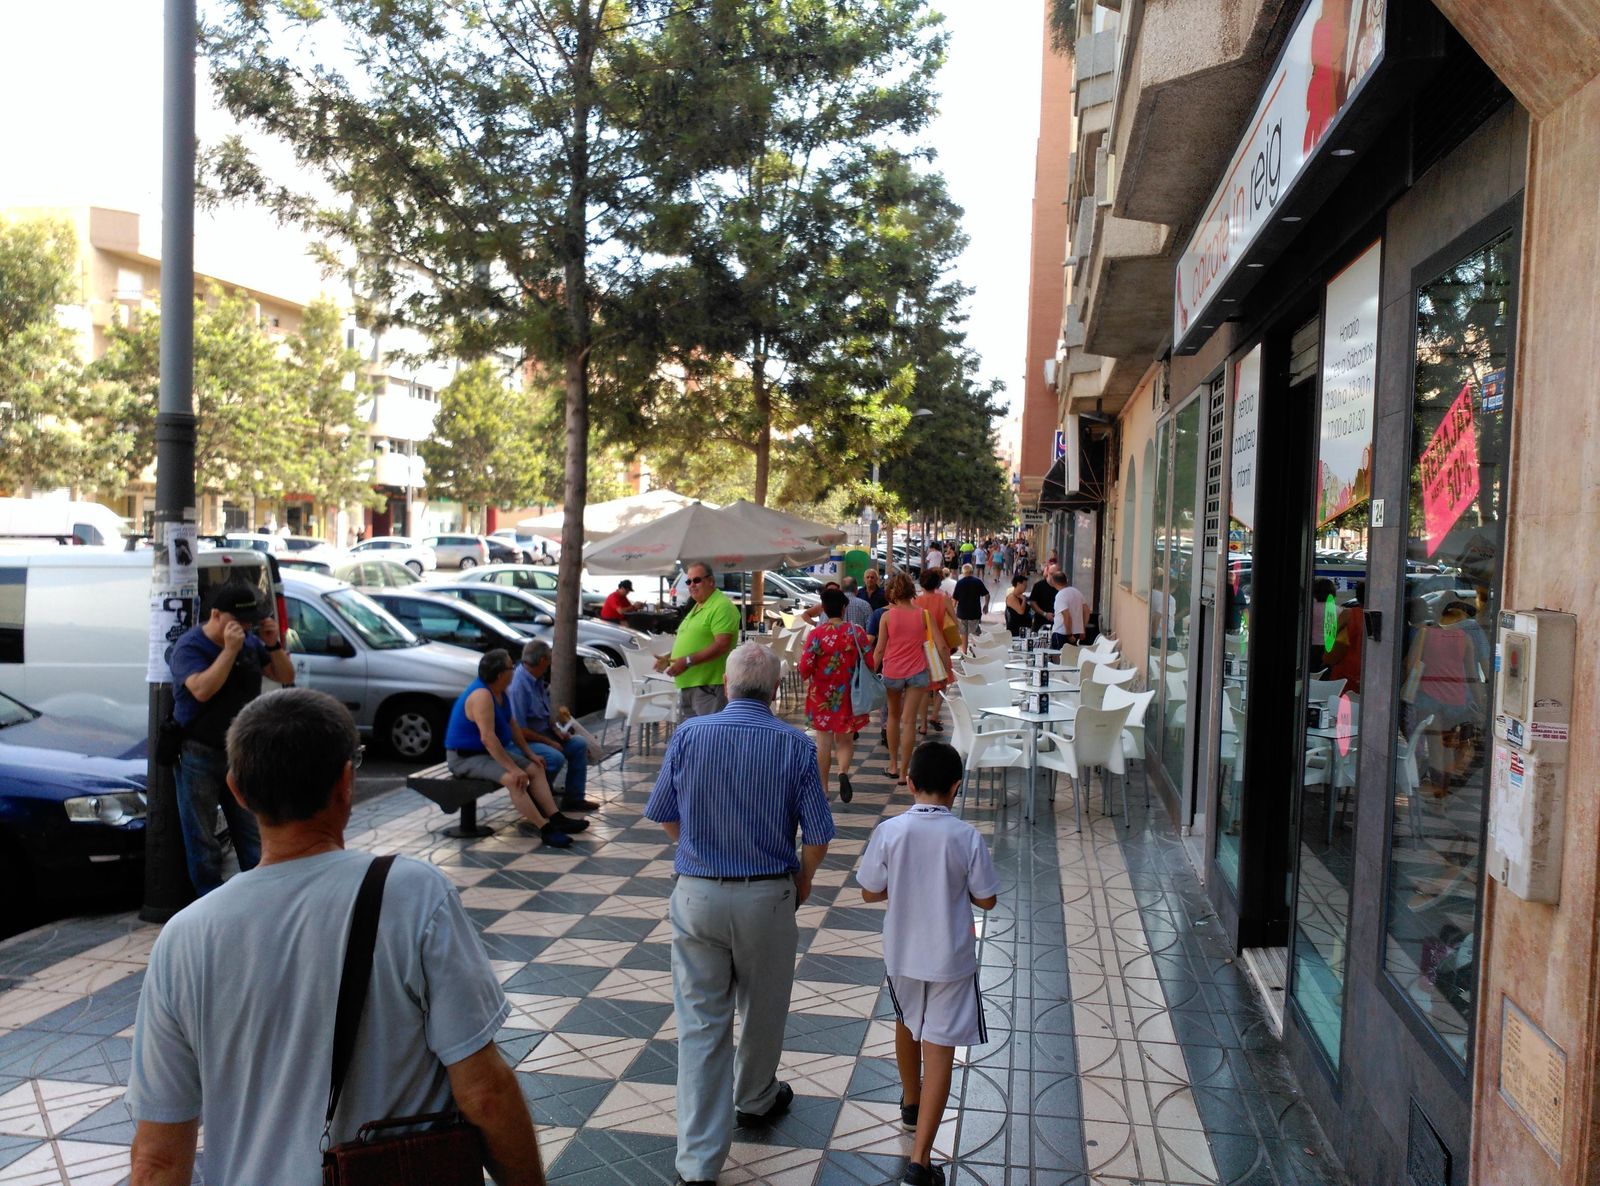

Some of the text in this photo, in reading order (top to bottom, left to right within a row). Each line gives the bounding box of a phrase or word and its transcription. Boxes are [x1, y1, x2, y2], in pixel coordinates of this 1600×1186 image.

[1232, 183, 1245, 245] in
[1250, 117, 1283, 221] reig
[1339, 316, 1360, 343] Horario
[1238, 393, 1254, 419] señora
[1234, 428, 1256, 455] caballero
[1422, 391, 1472, 491] REBAJAS
